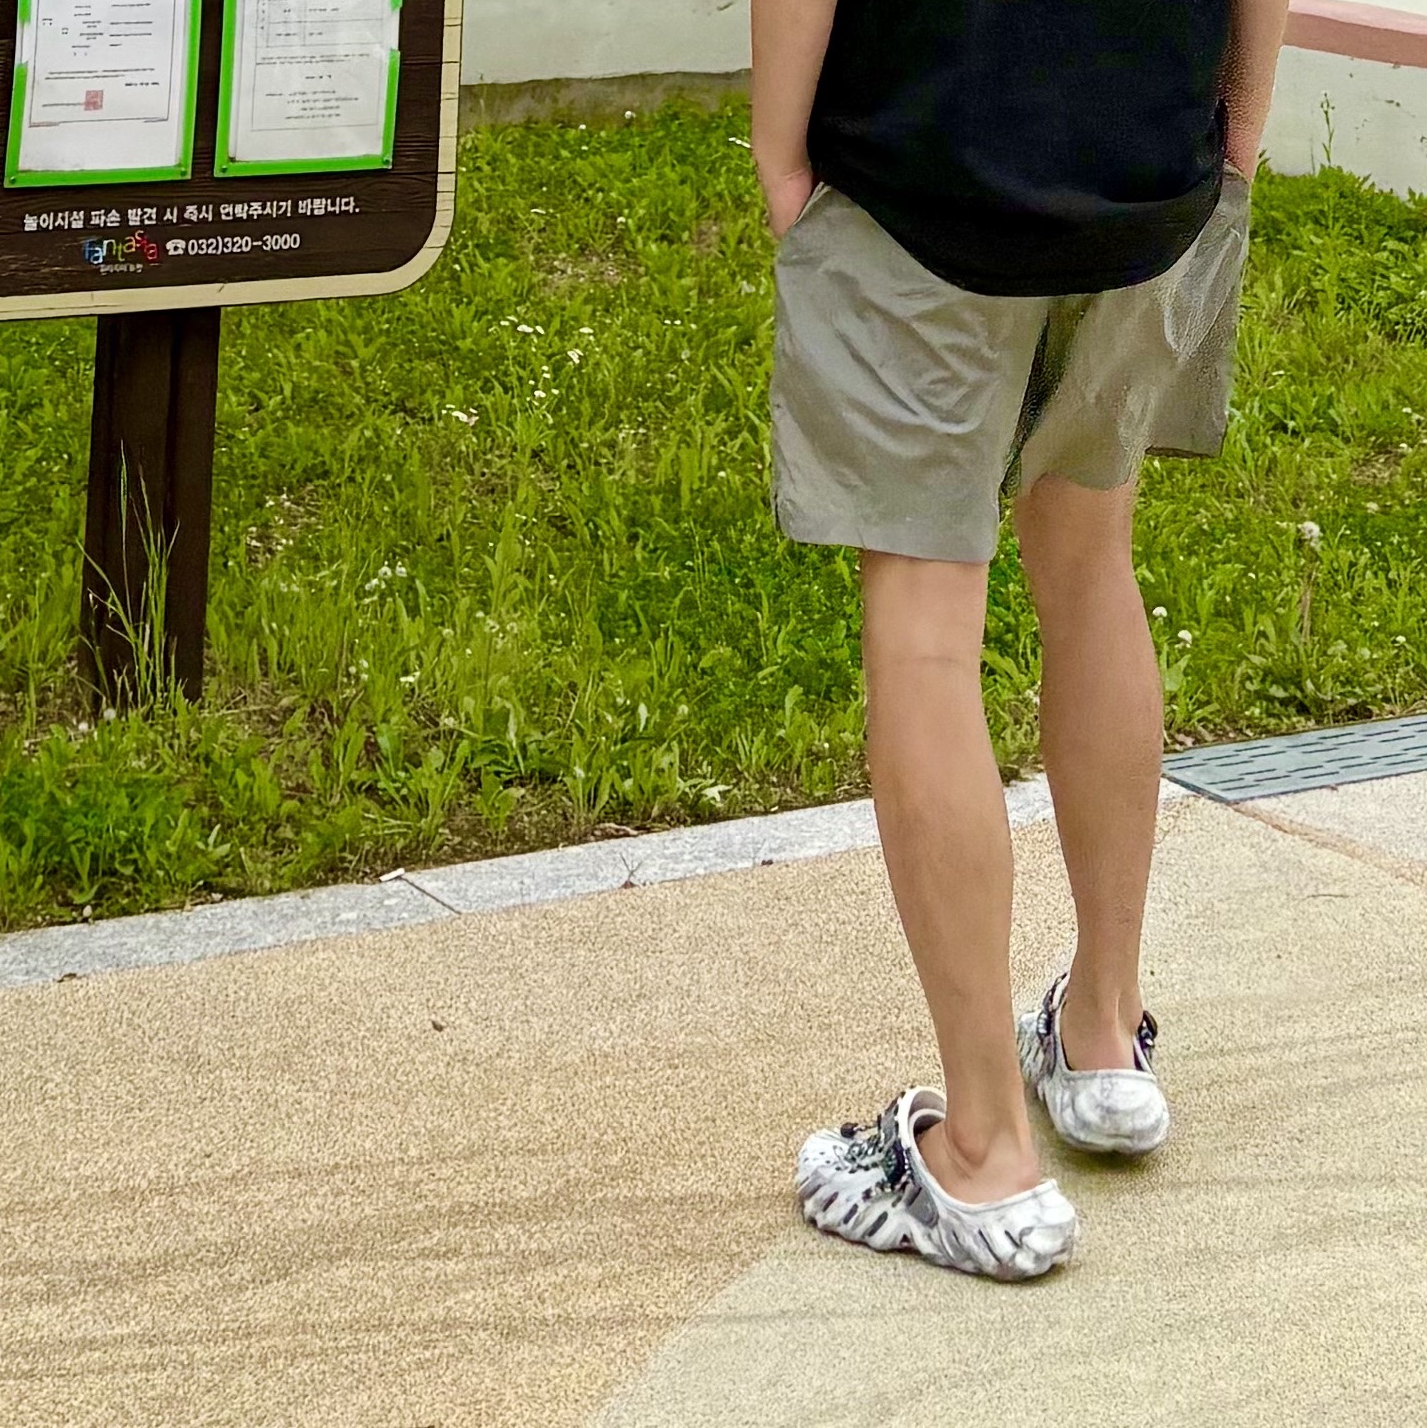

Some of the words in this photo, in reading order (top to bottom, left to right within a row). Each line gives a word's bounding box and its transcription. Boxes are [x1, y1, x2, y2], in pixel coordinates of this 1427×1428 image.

[23, 209, 85, 231] 놀이시설
[89, 208, 121, 228] 파손
[127, 206, 157, 226] 발견
[162, 205, 178, 224] 시
[219, 199, 292, 221] 연락주시기
[297, 196, 361, 216] 바랍니다.
[187, 233, 301, 256] 032)320-3000
